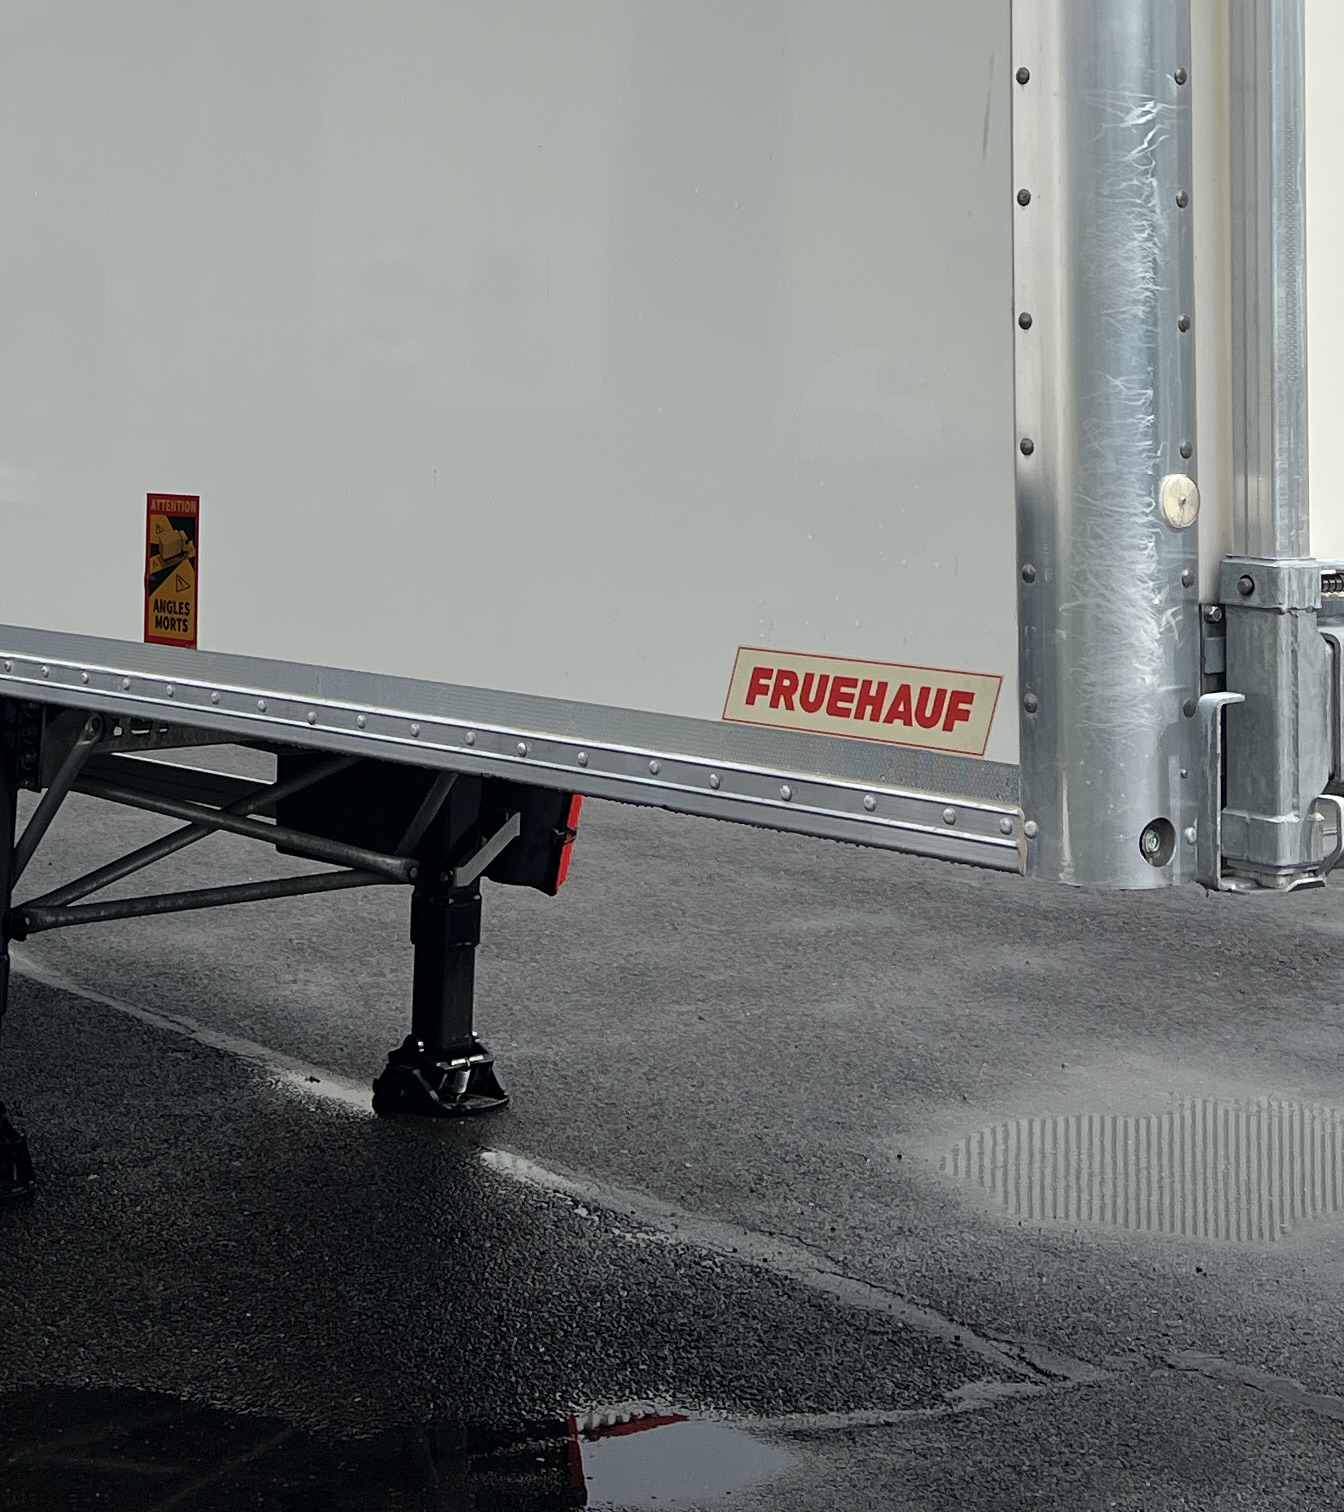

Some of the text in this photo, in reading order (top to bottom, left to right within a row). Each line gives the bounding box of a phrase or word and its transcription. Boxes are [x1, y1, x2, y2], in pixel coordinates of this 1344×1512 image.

[150, 498, 197, 514] ATTENTION
[153, 598, 190, 616] ANGLES
[154, 616, 188, 633] MORTS
[745, 666, 975, 732] FRUEHAUF
